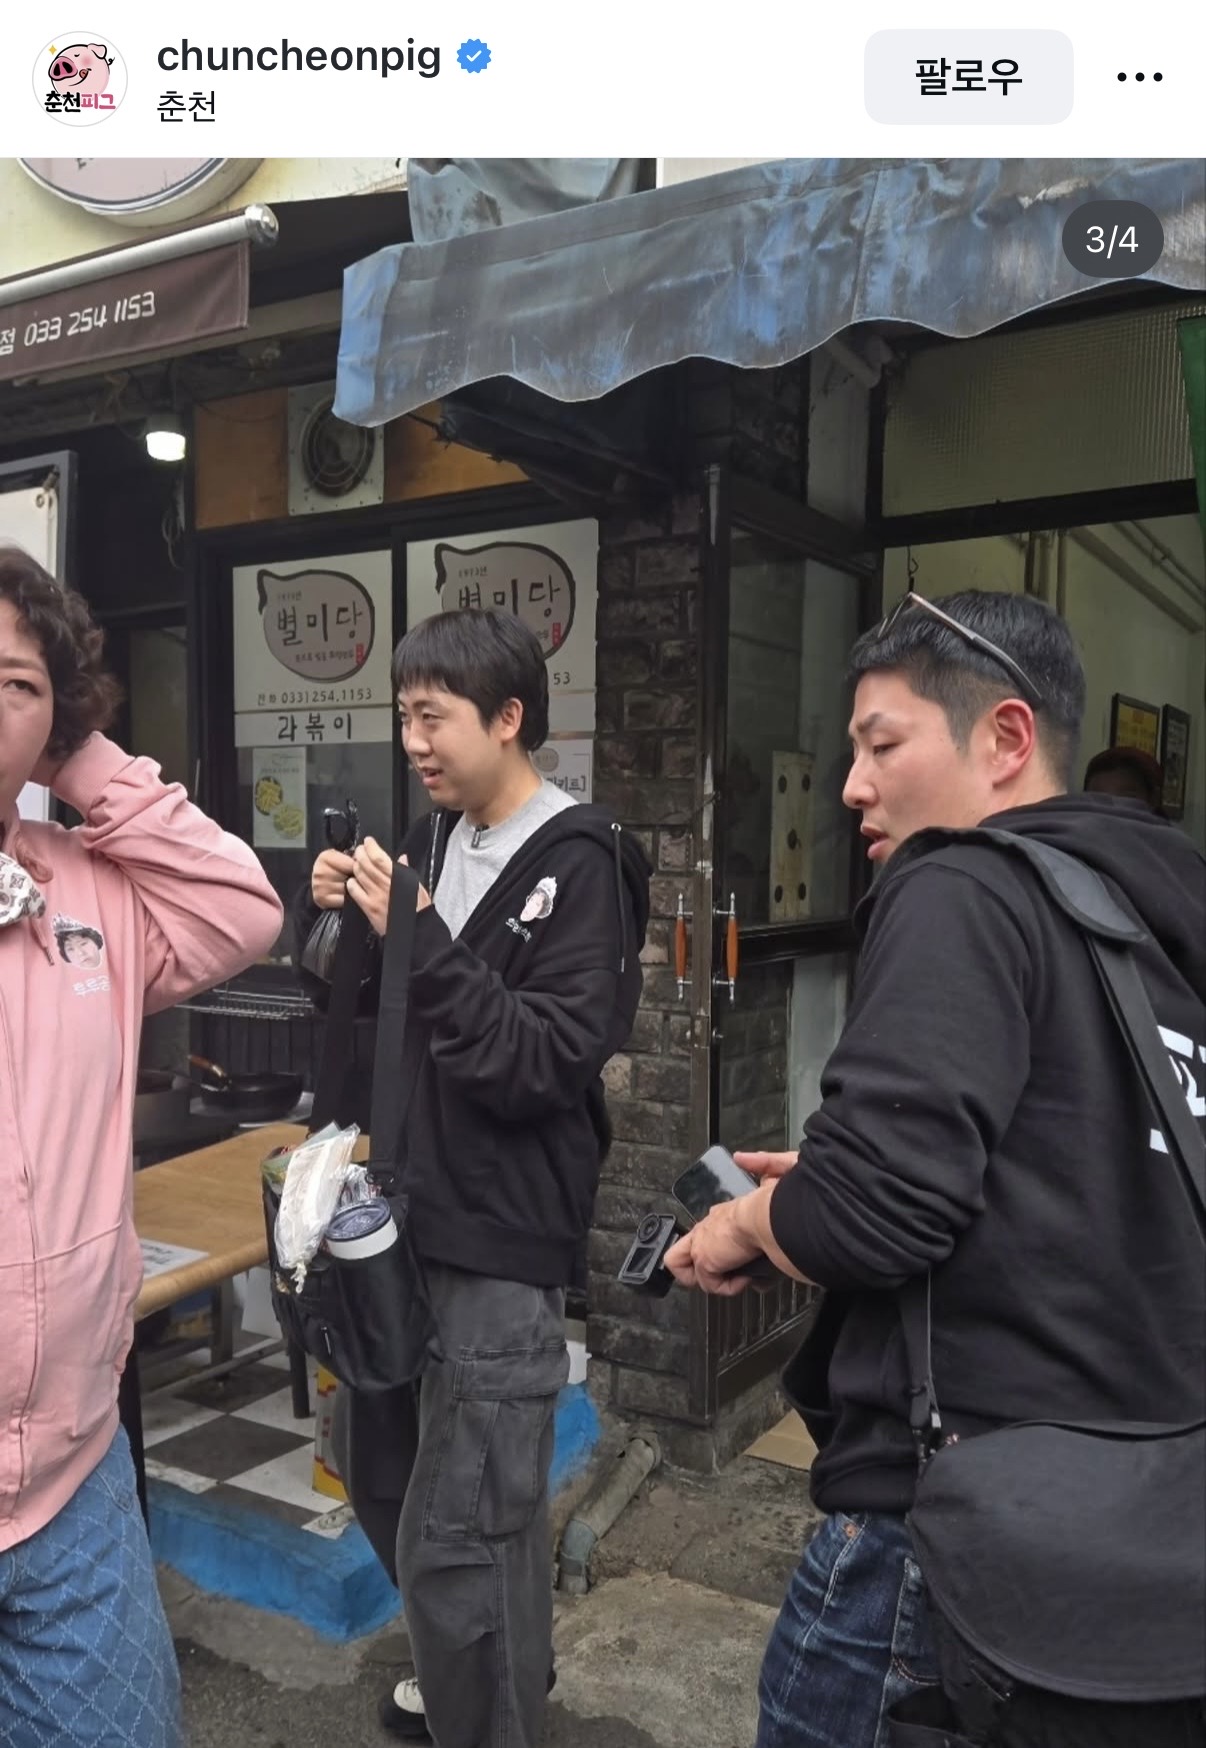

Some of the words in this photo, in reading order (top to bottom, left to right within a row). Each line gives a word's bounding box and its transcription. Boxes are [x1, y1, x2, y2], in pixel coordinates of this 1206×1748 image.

[24, 317, 62, 346] 033
[67, 304, 107, 336] 254
[113, 291, 156, 323] 1153
[277, 601, 363, 647] 별미당
[278, 712, 352, 742] 라볶이
